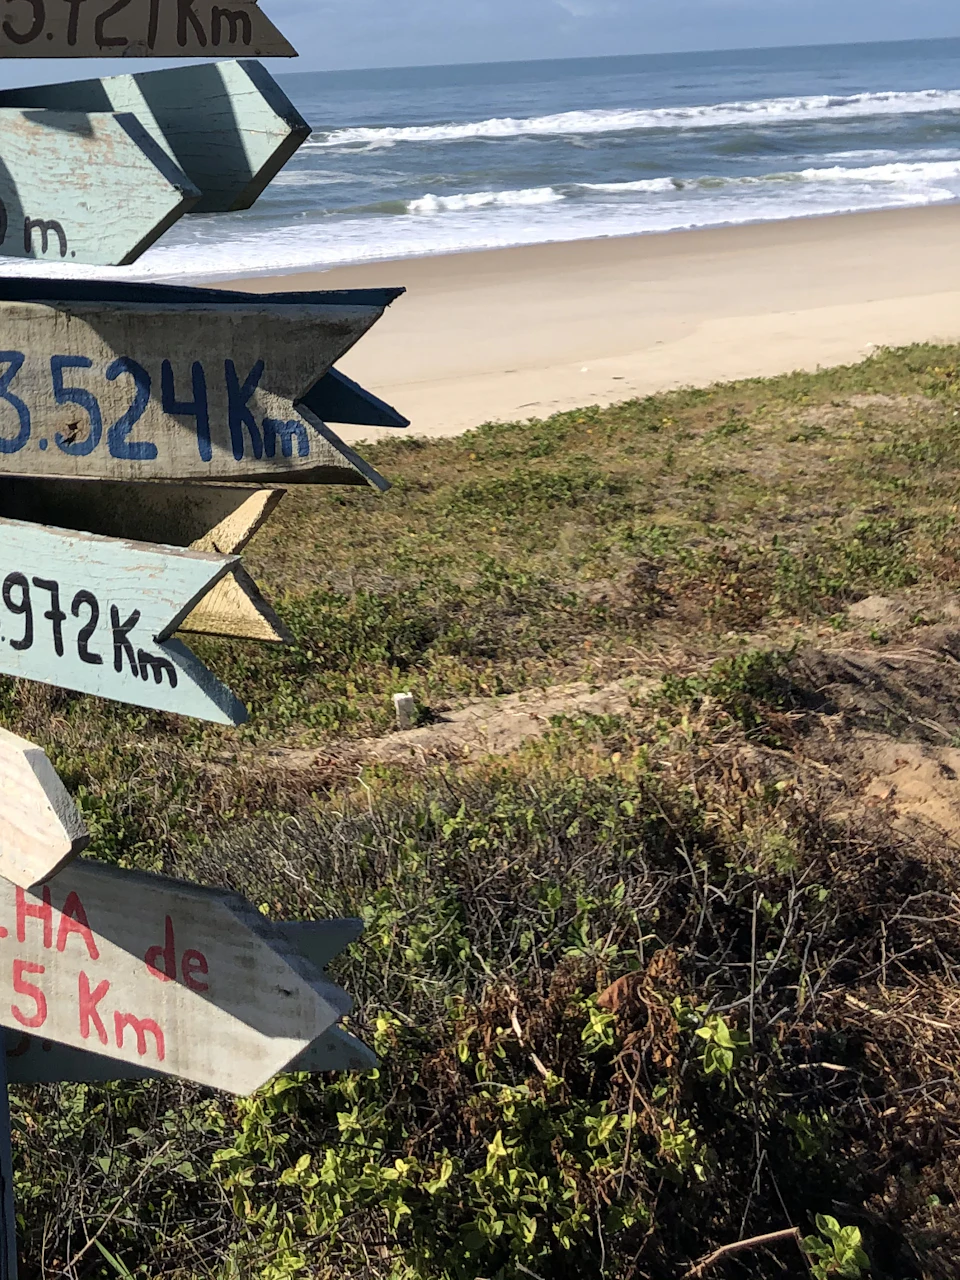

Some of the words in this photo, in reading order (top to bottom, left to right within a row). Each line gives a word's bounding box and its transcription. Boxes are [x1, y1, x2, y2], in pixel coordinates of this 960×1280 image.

[23, 214, 77, 259] m.
[224, 358, 311, 461] Km
[110, 604, 178, 689] Km
[144, 915, 210, 992] de
[10, 958, 48, 1028] 5
[78, 970, 166, 1062] Km
